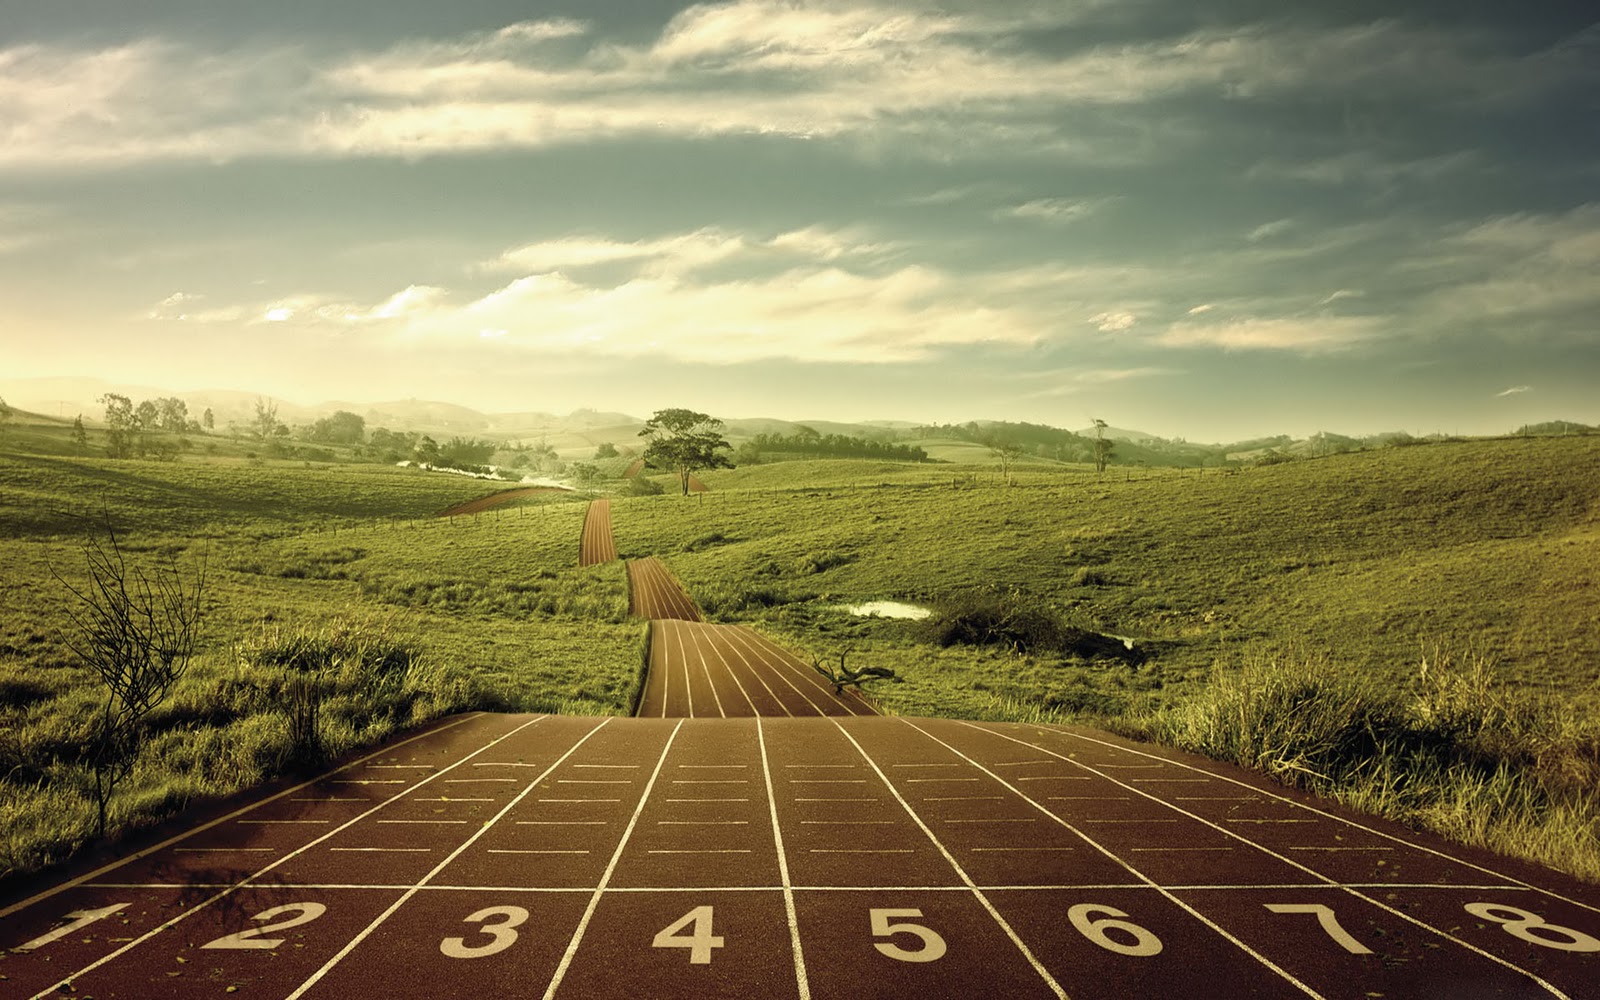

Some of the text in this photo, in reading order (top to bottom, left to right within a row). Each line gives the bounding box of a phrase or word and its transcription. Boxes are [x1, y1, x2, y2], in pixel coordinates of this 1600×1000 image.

[18, 902, 131, 950] 1
[201, 902, 327, 949] 2
[440, 906, 530, 958] 3
[652, 906, 724, 964] 4
[870, 909, 946, 963] 5
[1068, 904, 1163, 956] 6
[1264, 903, 1373, 955] 7
[1464, 902, 1600, 953] 8
